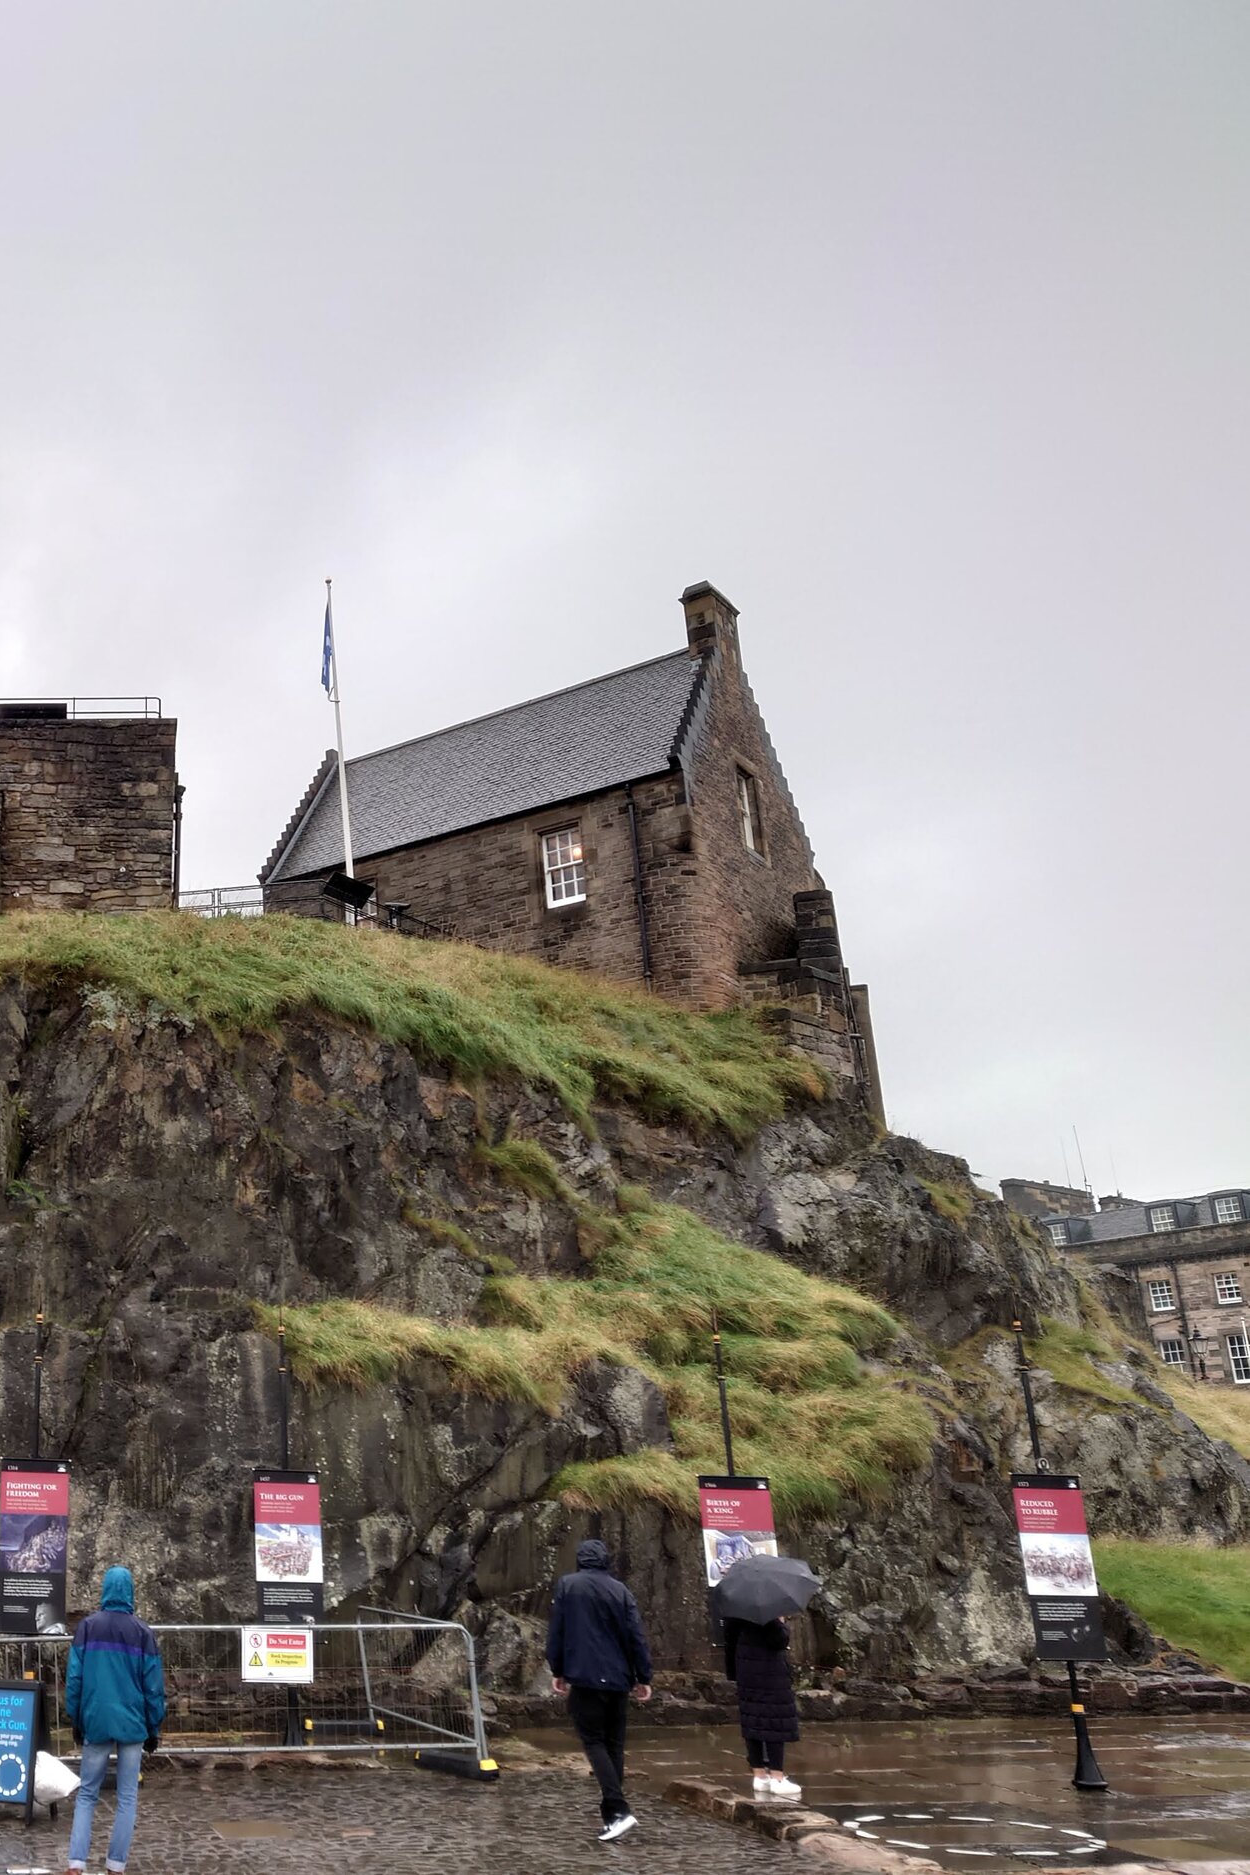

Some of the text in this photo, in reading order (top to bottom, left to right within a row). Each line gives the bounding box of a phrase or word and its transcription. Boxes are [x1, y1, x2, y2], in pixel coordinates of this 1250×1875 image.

[6, 1481, 41, 1490] FIGHTING
[1020, 1499, 1054, 1507] REDUCED
[269, 1637, 277, 1645] Do
[288, 1638, 304, 1646] Enter
[10, 1695, 24, 1706] for
[8, 1720, 27, 1730] Gun.
